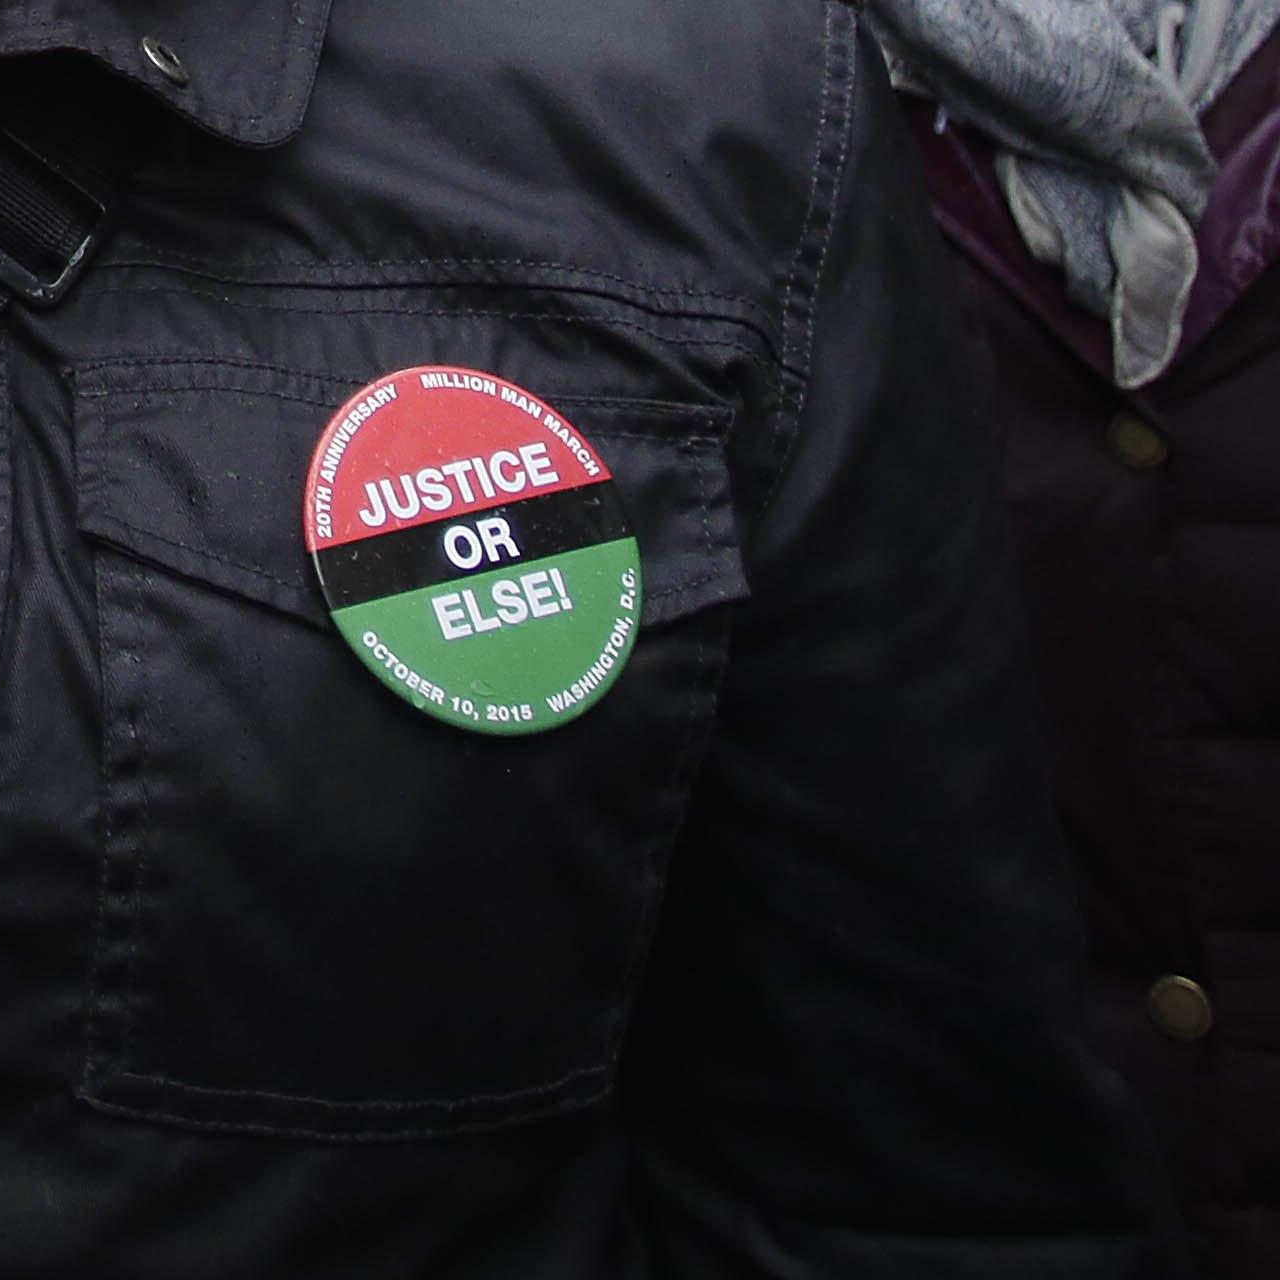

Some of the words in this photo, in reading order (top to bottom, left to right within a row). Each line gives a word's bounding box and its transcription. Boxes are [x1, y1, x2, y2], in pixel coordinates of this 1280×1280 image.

[320, 383, 398, 484] ANNIVERSARY
[420, 372, 497, 397] MILLION
[501, 386, 542, 418] MAN
[543, 413, 600, 478] MARCH
[316, 484, 333, 538] 20TH
[358, 441, 559, 528] JUSTICE
[443, 517, 521, 570] OR
[431, 567, 573, 641] ELSE!
[362, 630, 445, 706] OCTOBER
[450, 695, 480, 721] 10,
[487, 704, 534, 722] 2015
[546, 615, 635, 715] WASHINGTON,
